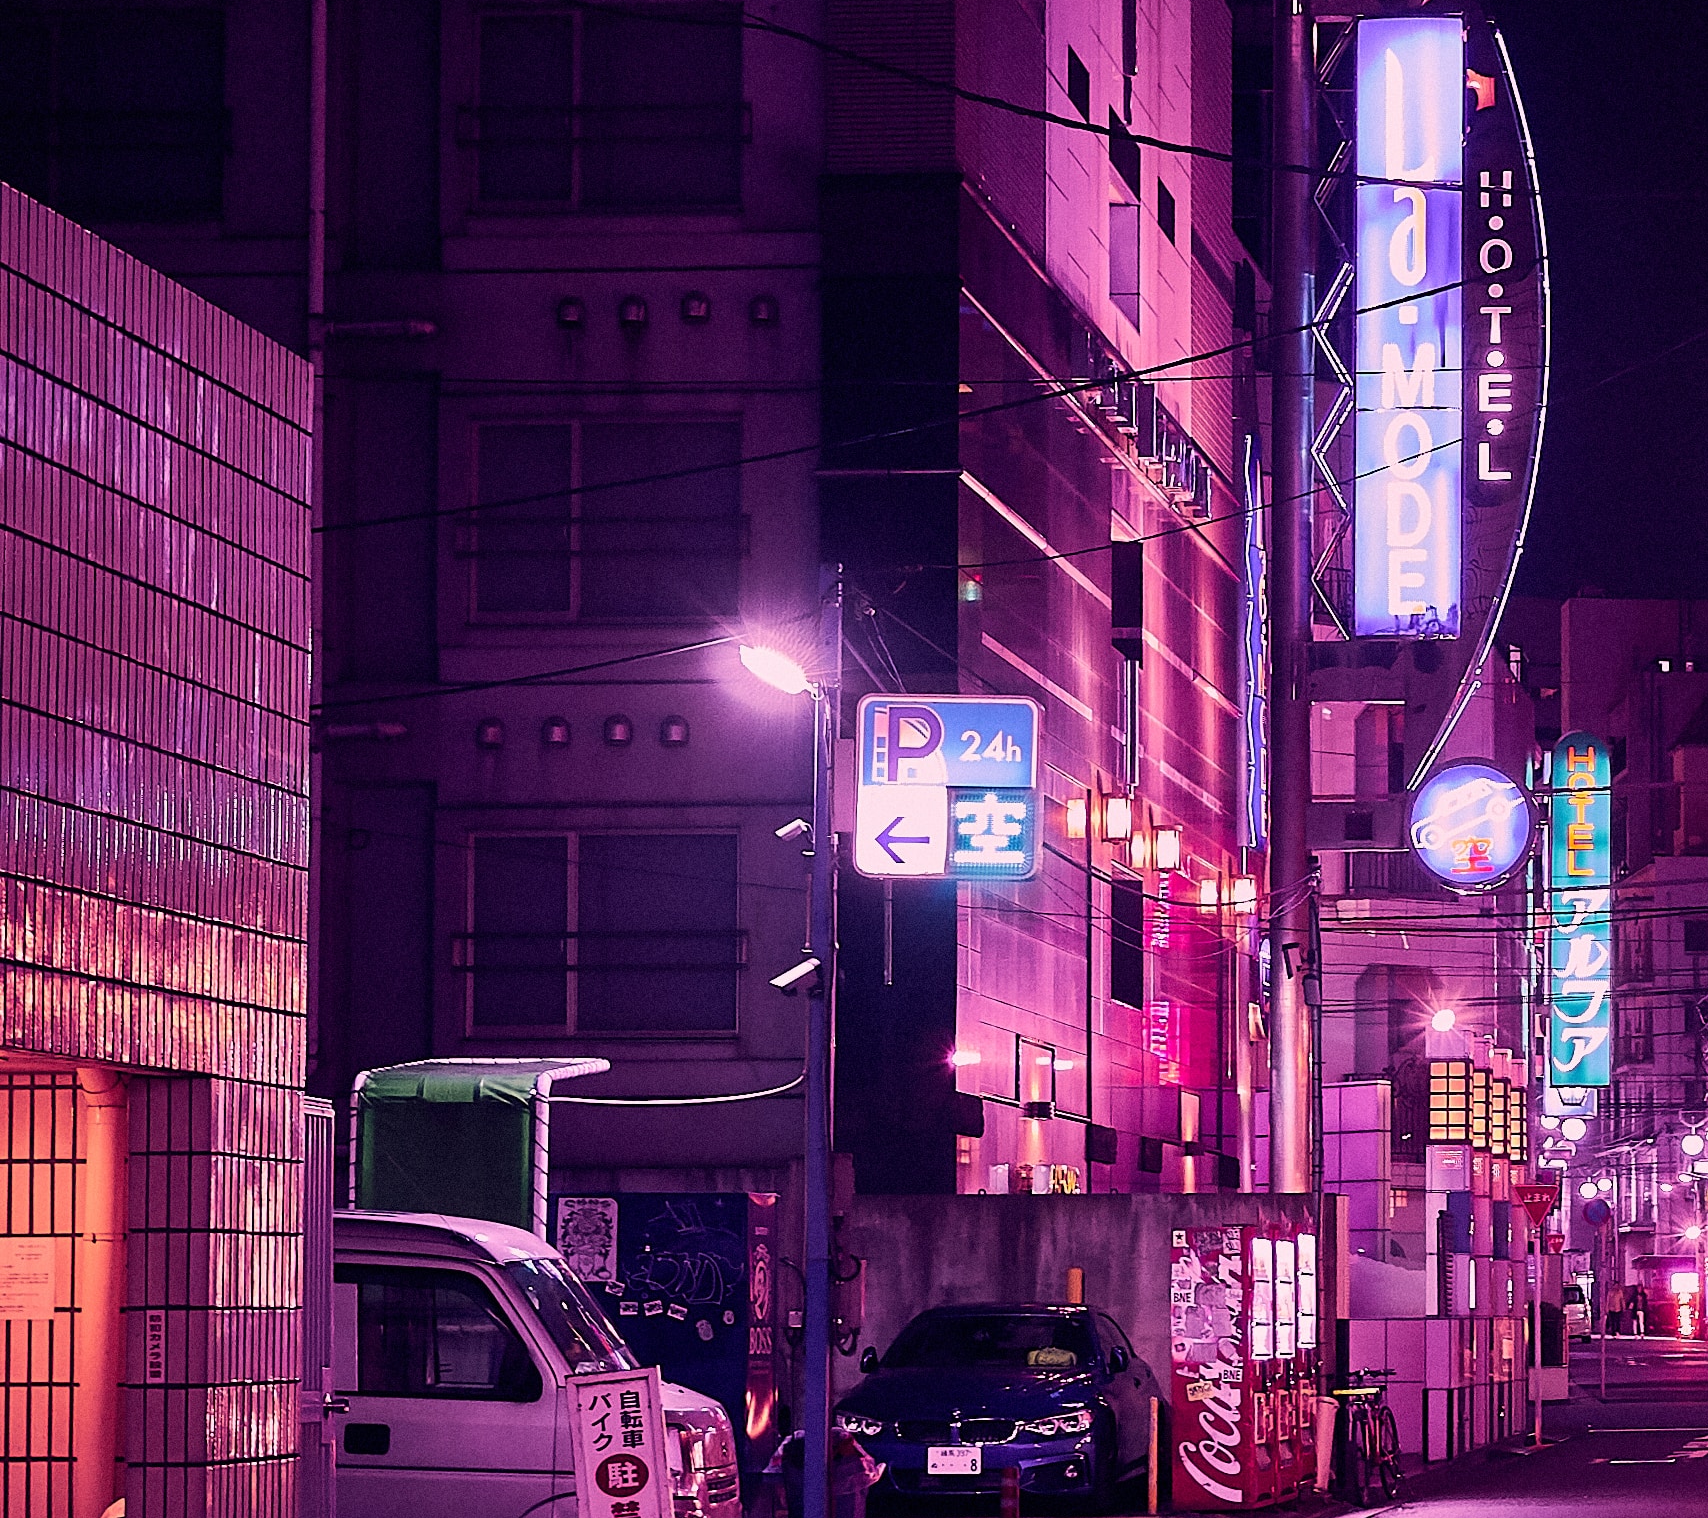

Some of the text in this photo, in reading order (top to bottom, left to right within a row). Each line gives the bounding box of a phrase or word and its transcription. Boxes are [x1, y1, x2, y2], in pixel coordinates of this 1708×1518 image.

[959, 729, 1023, 765] 24h
[953, 791, 1027, 865] 空
[1565, 746, 1596, 877] HOTEL
[1449, 837, 1495, 875] 空
[1551, 891, 1611, 1075] アルファ
[1523, 1192, 1552, 1203] 止まれ
[1172, 1292, 1192, 1304] BNE
[748, 1326, 773, 1356] BOSS
[1222, 1369, 1241, 1382] BNE
[588, 1392, 614, 1453] バイク
[619, 1389, 646, 1450] 自転車
[607, 1460, 641, 1490] 駐
